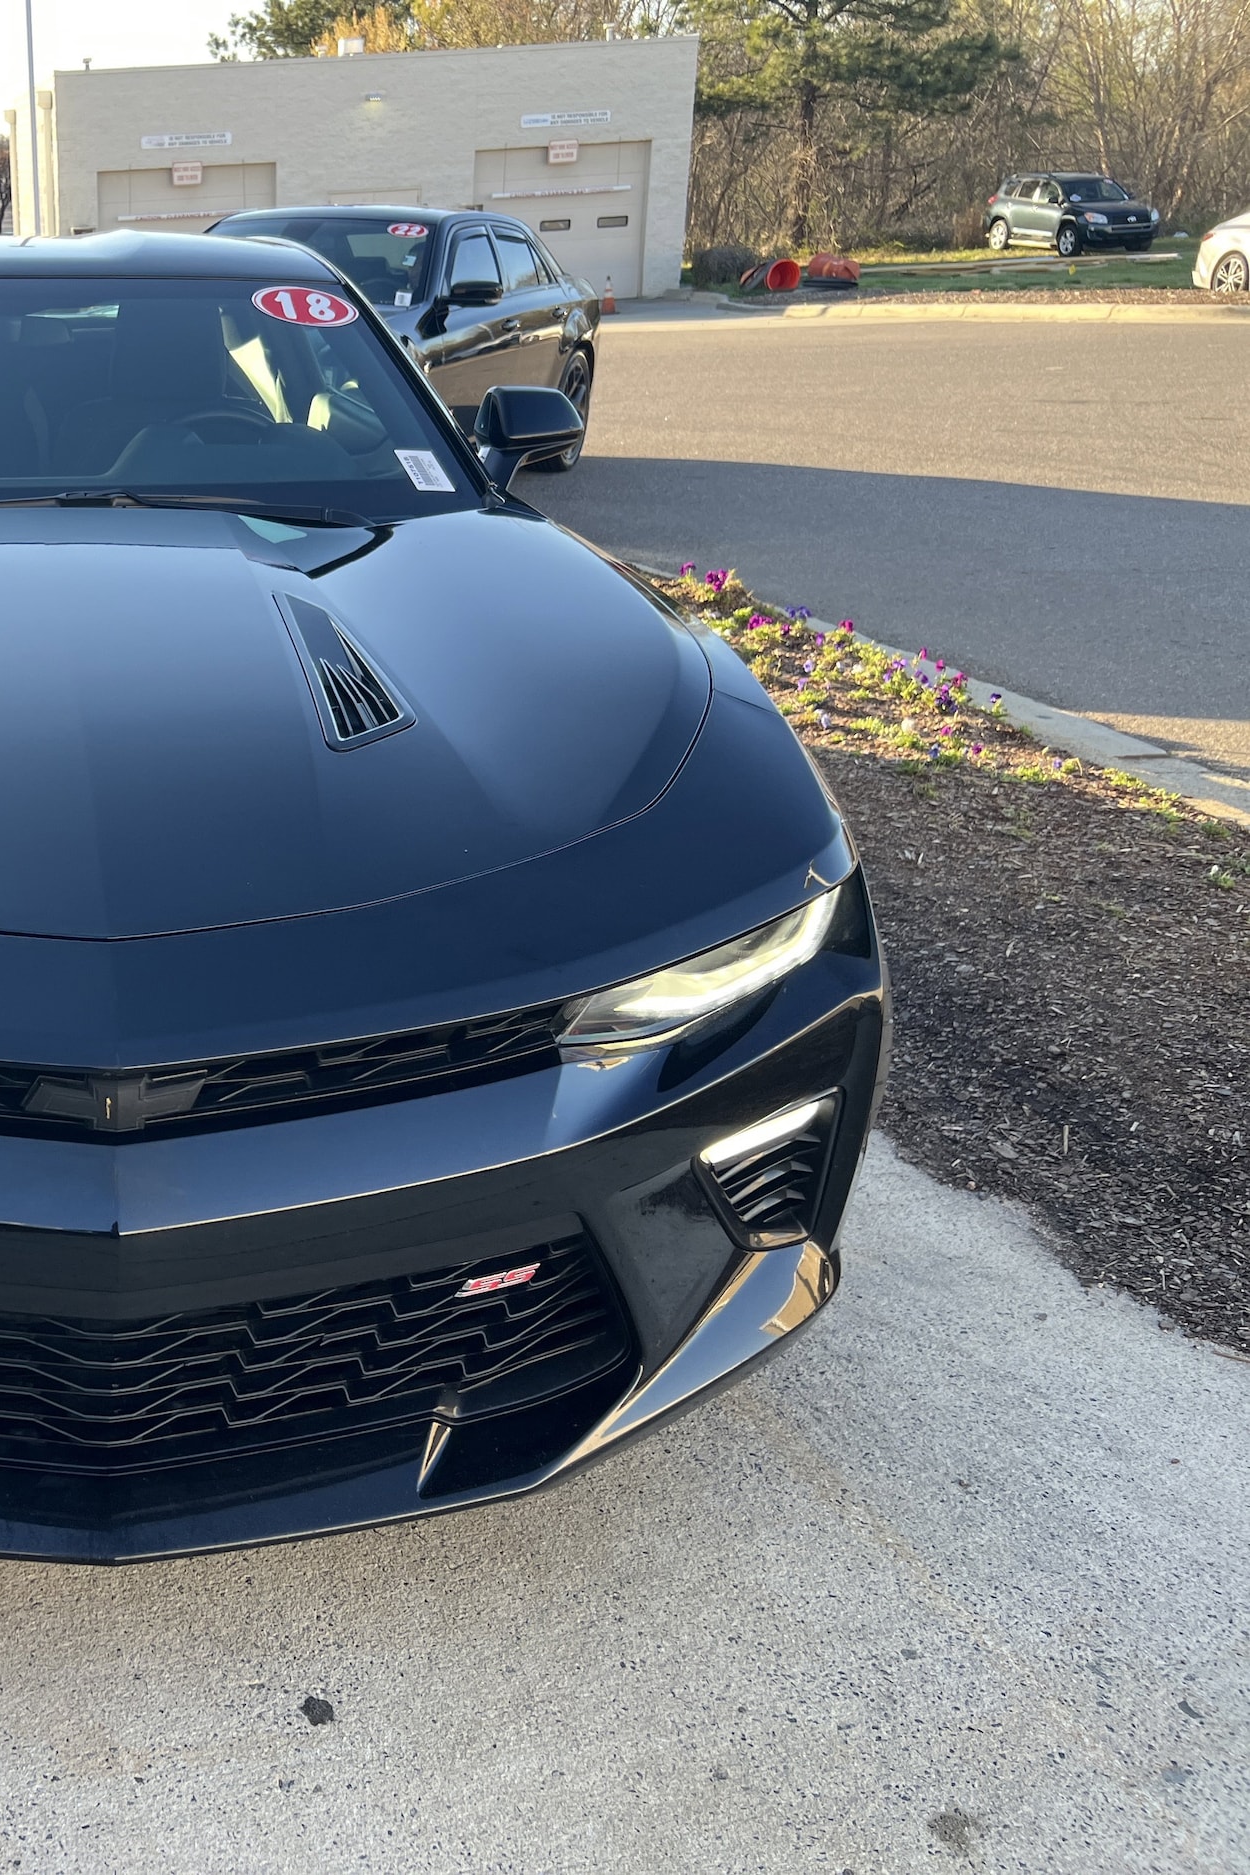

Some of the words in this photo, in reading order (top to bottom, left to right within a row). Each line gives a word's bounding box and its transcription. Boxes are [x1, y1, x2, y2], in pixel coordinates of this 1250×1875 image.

[395, 224, 421, 236] 22
[274, 291, 336, 321] 18
[454, 1262, 541, 1298] SS
